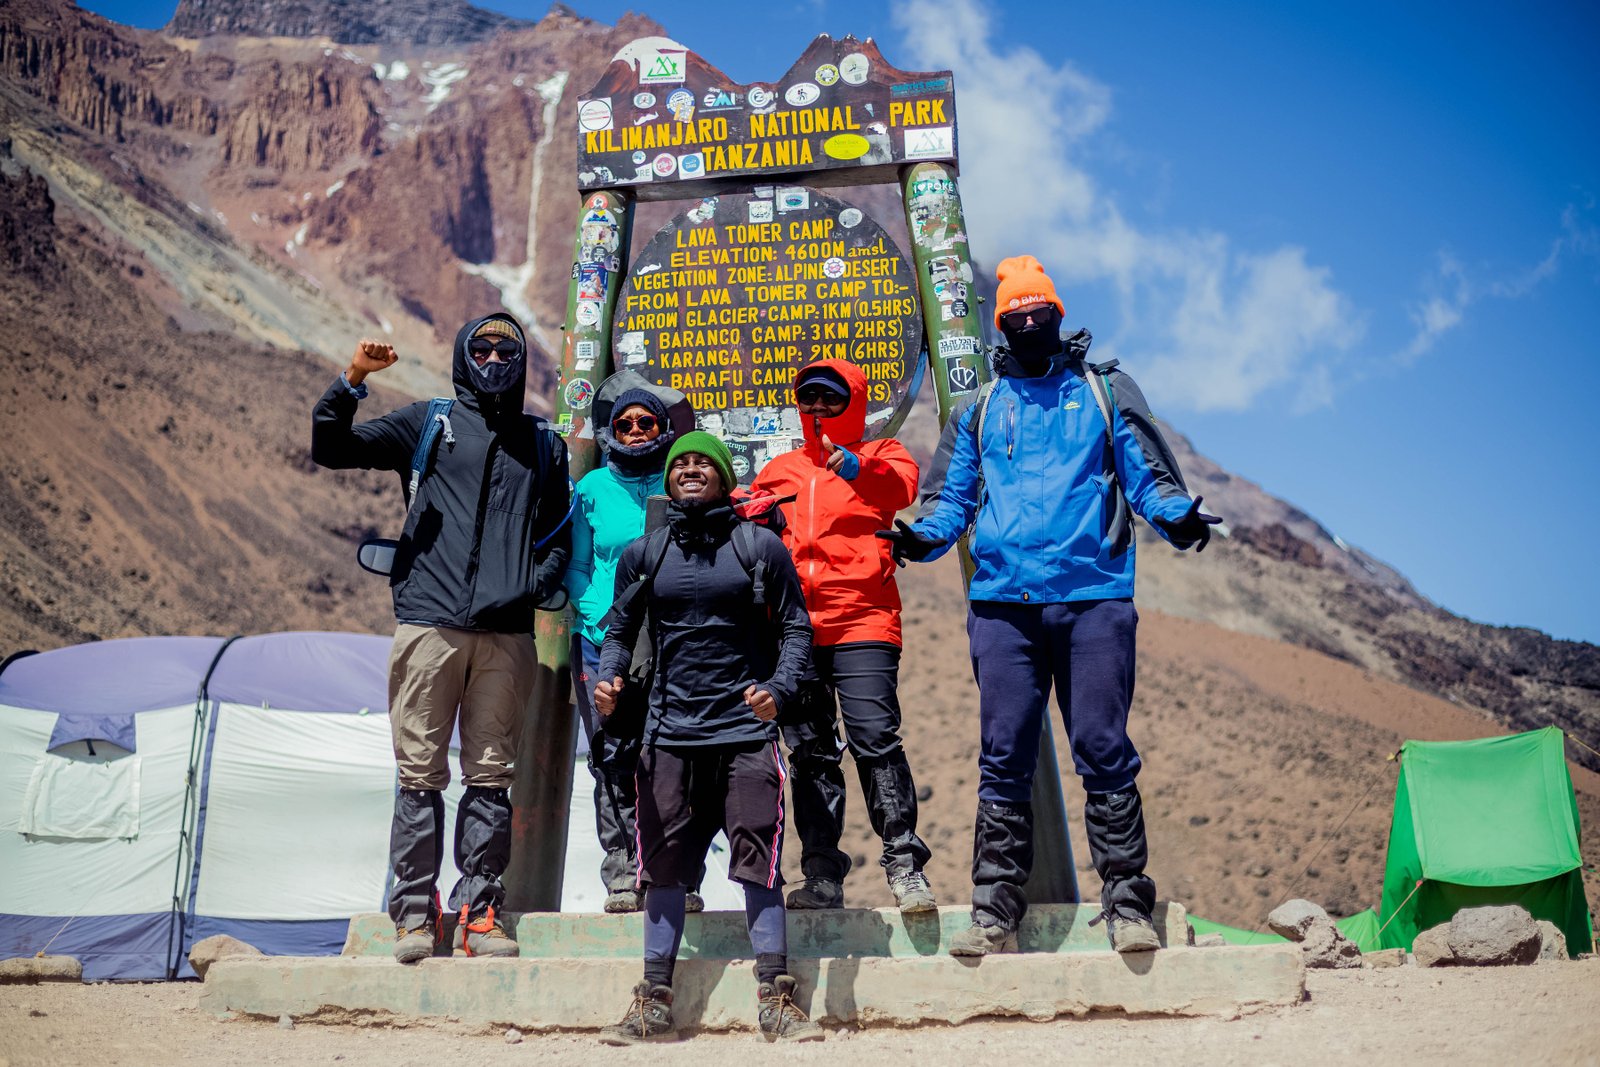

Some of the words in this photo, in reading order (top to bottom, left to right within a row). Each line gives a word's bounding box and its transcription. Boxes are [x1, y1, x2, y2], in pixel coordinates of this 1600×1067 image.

[586, 117, 728, 154] KILIMANJARO
[749, 105, 861, 139] NATIONAL
[889, 99, 947, 127] PARK
[701, 138, 813, 172] TANZANIA
[676, 227, 717, 248] LAVA
[725, 223, 782, 244] TOWER
[789, 218, 834, 240] CAMP
[670, 246, 777, 268] ELEVATION:
[785, 240, 845, 261] 4600M
[847, 237, 887, 258] amsl
[632, 268, 717, 291] VEGETATION
[843, 257, 899, 278] DESERT
[626, 291, 679, 312] FROM
[686, 287, 731, 307] LAVA
[745, 283, 807, 303] TOWER
[816, 280, 867, 299] CAMP
[1021, 293, 1047, 305] BMA
[627, 312, 678, 331] ARROW
[686, 307, 759, 327] GLACIER
[768, 303, 820, 322] CAMP:
[854, 295, 916, 320] (0.5HRS)
[659, 328, 741, 349] BARANCO
[751, 324, 806, 344] CAMP:
[660, 349, 742, 369] KARANGA
[751, 345, 803, 364] CAMP:
[808, 343, 847, 361] 9KM
[850, 339, 905, 363] (6HRS)
[671, 369, 743, 390] BARAFU
[686, 391, 727, 409] URU
